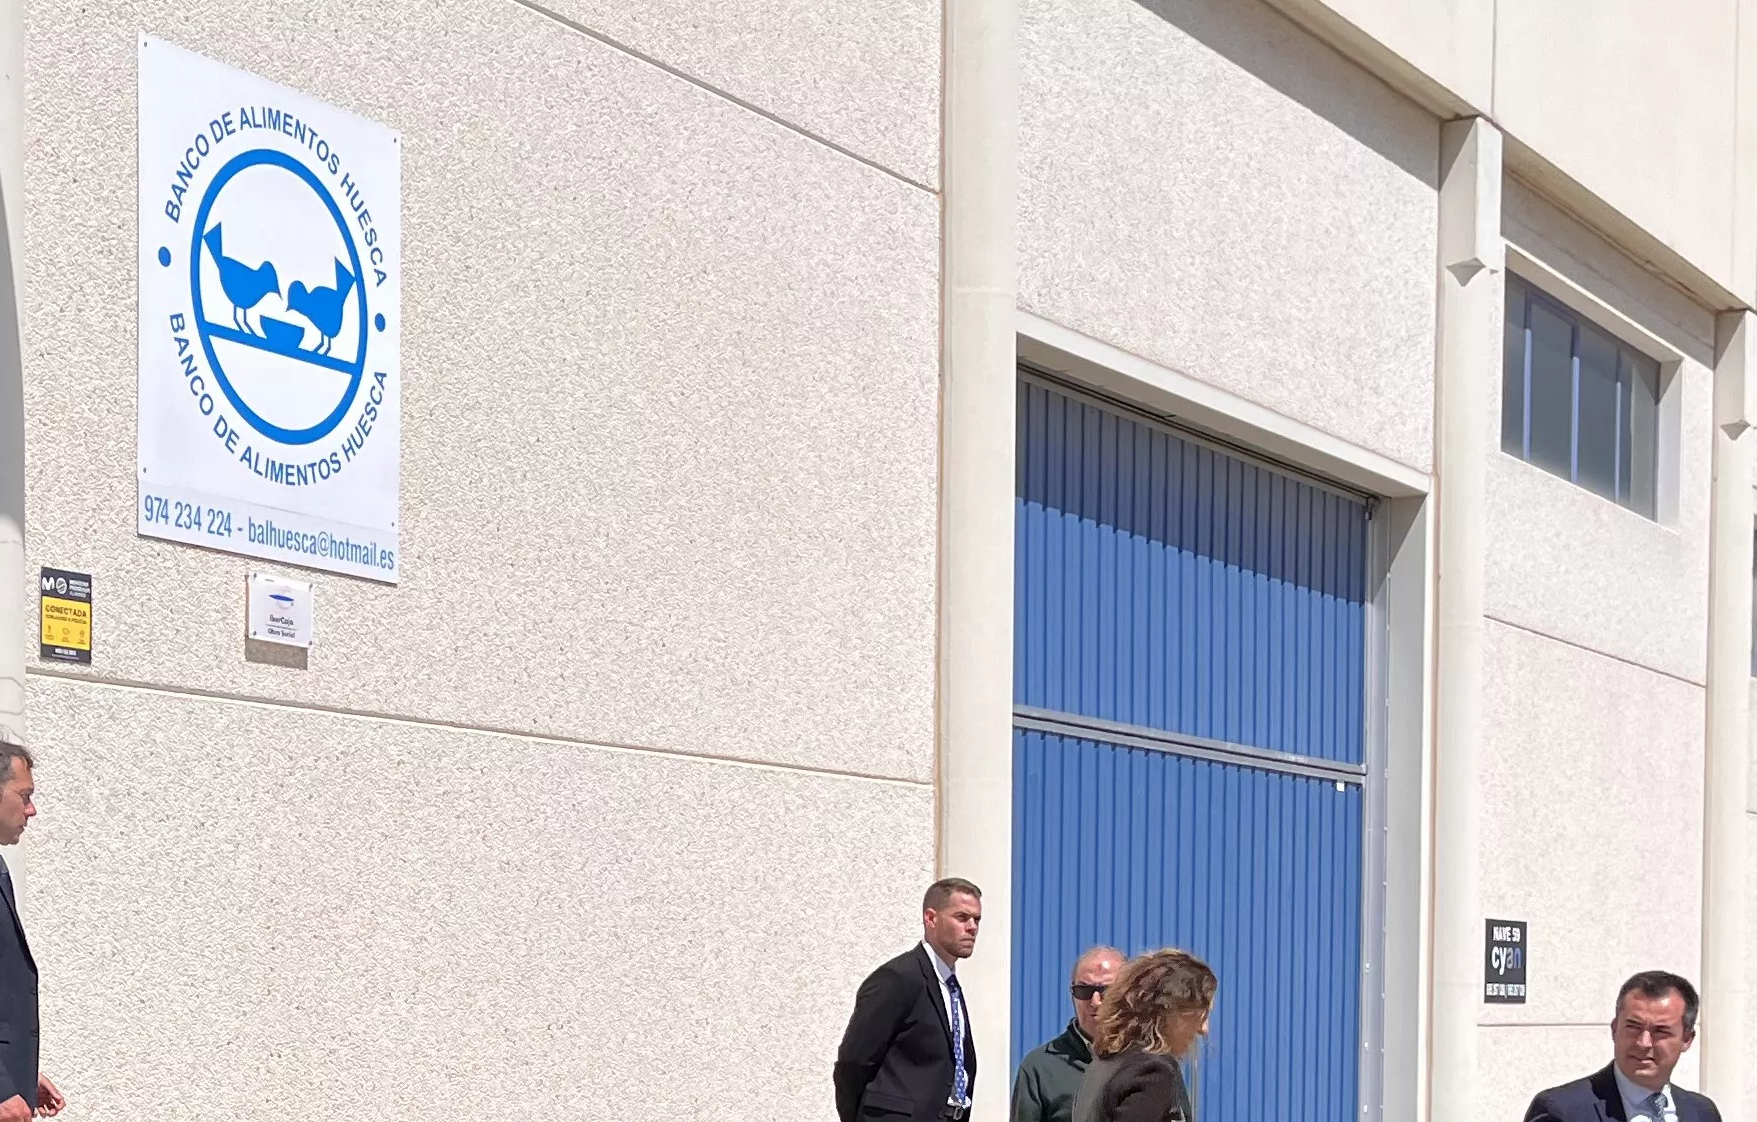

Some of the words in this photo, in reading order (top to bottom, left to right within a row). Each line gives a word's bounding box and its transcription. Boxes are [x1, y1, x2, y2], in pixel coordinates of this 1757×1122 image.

[165, 134, 209, 224] BANCO
[208, 112, 237, 144] DE
[238, 106, 340, 175] ALIMENTOS
[340, 173, 387, 287] HUESCA
[169, 313, 214, 416] BANCO
[213, 414, 241, 454] DE
[239, 448, 342, 487] ALIMENTOS
[343, 371, 387, 463] HUESCA
[144, 495, 169, 525] 974
[174, 501, 202, 532] 234
[207, 508, 232, 538] 224
[248, 516, 394, 570] balhuesca@hotmail.es
[45, 604, 87, 618] CONECTADA
[1493, 926, 1511, 941] NAVE
[1491, 945, 1521, 975] cyan
